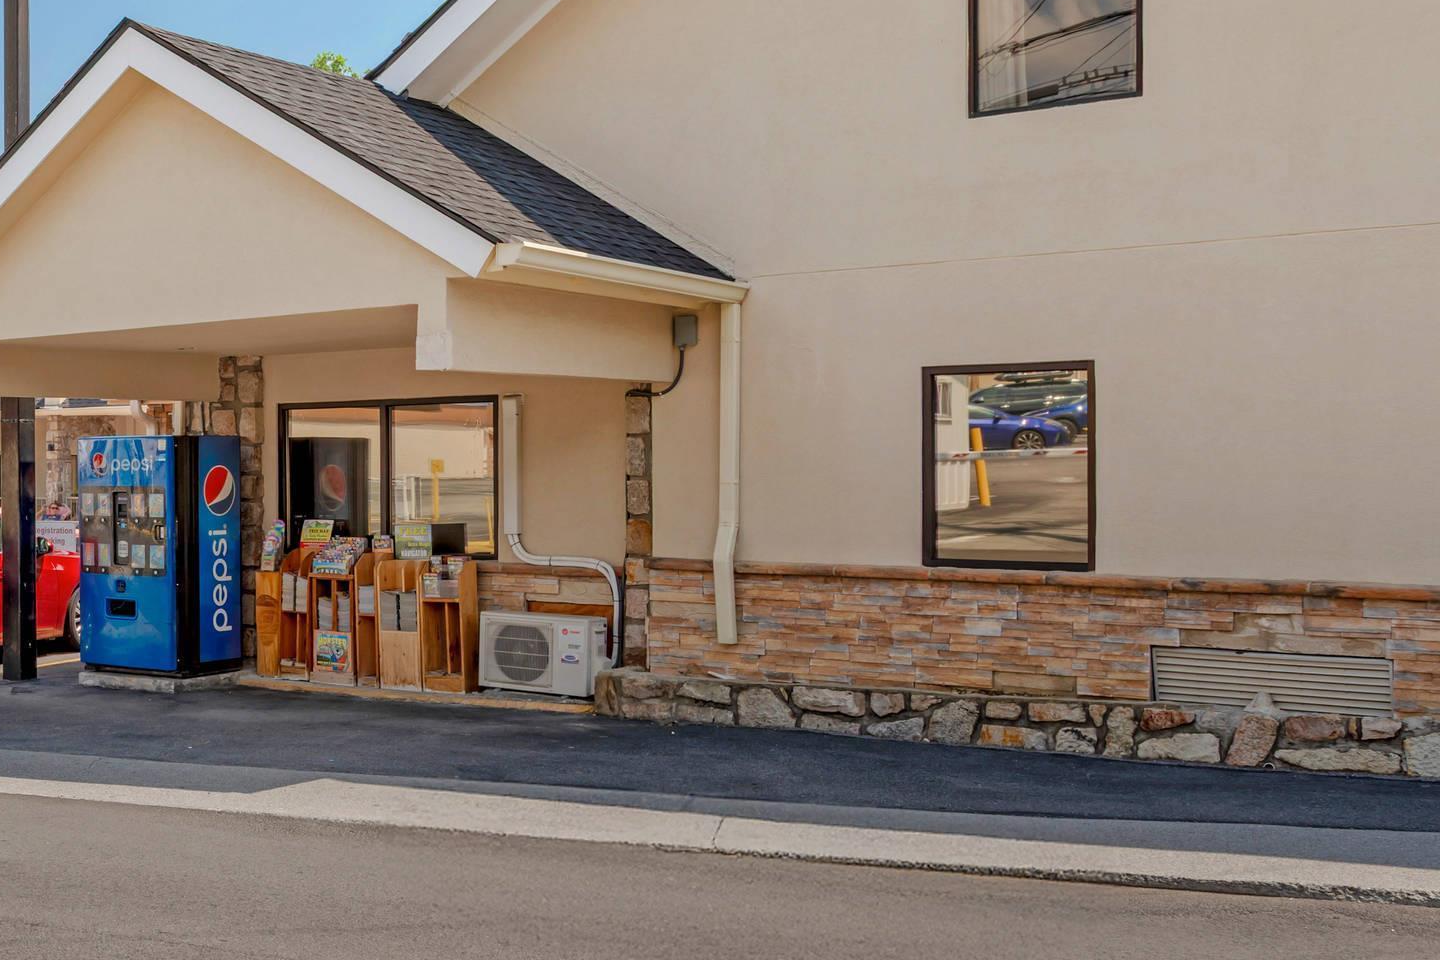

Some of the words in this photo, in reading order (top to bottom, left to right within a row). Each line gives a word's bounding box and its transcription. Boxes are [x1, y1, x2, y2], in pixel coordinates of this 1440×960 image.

[111, 456, 153, 474] pepsi
[36, 527, 73, 535] egistration
[208, 529, 233, 632] pepsi
